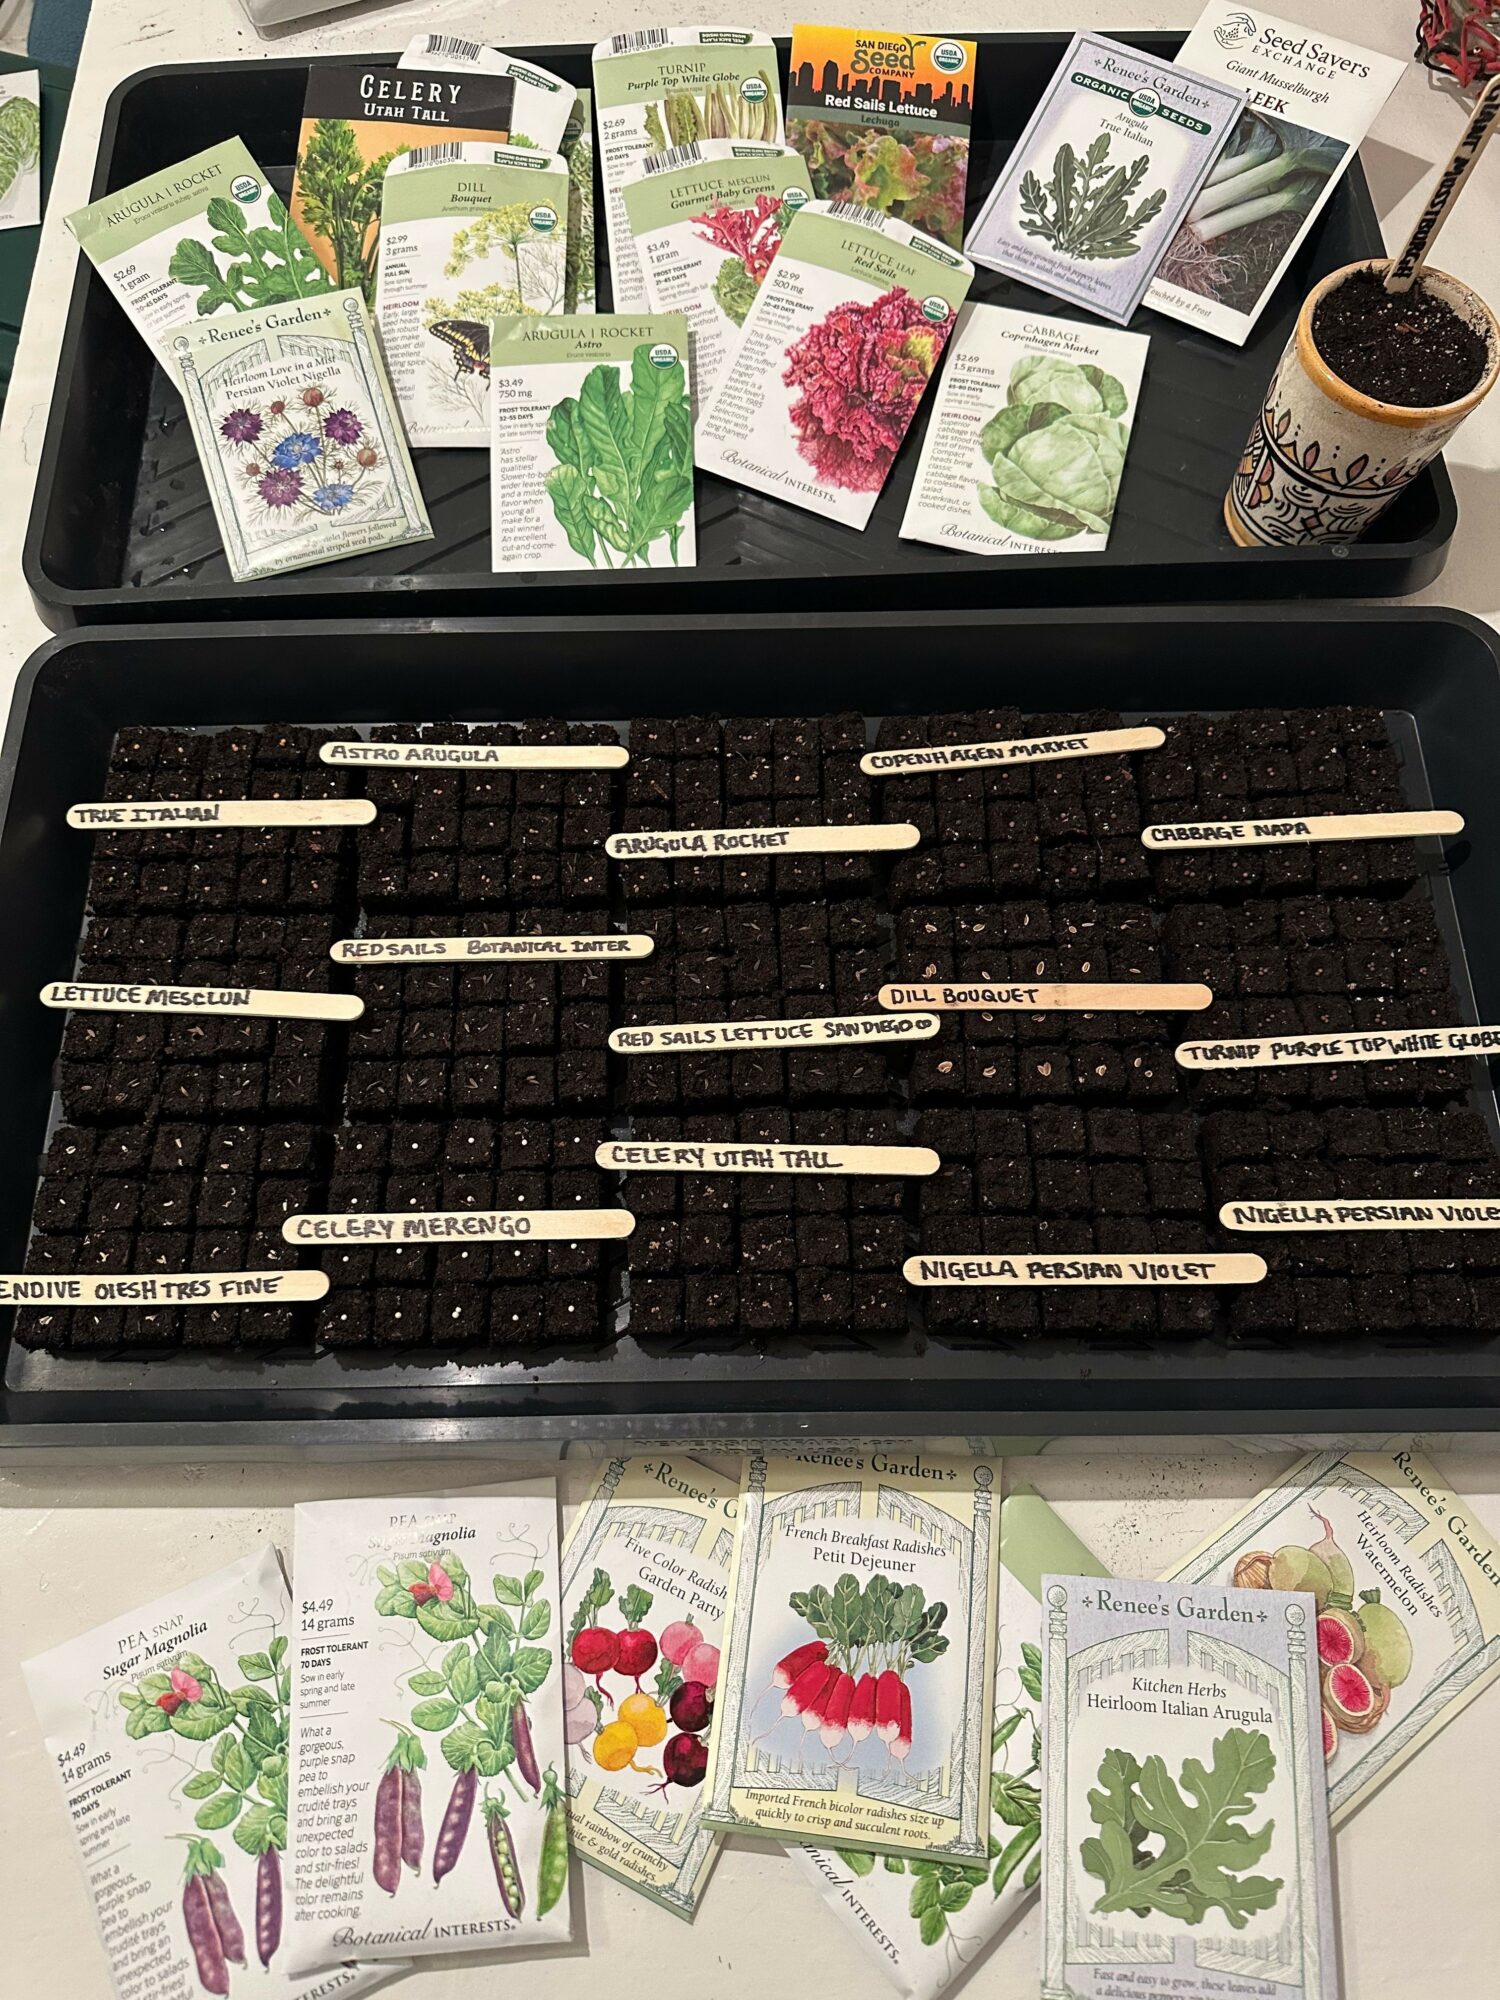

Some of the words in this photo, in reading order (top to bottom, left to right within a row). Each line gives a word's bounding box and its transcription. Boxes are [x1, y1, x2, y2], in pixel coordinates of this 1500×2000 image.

[850, 38, 916, 74] Seed
[856, 40, 875, 49] SAN
[878, 42, 907, 53] DIEGO
[1259, 29, 1307, 54] Seed
[1306, 42, 1370, 78] Savers
[658, 63, 706, 75] TURNIP
[869, 67, 915, 78] COMPANY
[1252, 45, 1337, 80] EXCHANGE
[360, 74, 462, 104] CELERY
[627, 80, 658, 91] Purple
[661, 77, 679, 87] Top
[681, 74, 710, 83] White
[712, 72, 740, 81] Globe
[1074, 74, 1129, 100] ORGANIC
[1102, 57, 1150, 84] Renee's
[1152, 74, 1201, 106] Garden
[1226, 60, 1258, 79] Giant
[1260, 71, 1330, 104] Musselburgh
[825, 94, 851, 108] Red
[854, 98, 886, 111] Sails
[889, 101, 937, 118] Lettuce
[1462, 84, 1500, 153] GIANT
[861, 115, 899, 127] Lechuga
[1116, 112, 1149, 131] Arugula
[1162, 108, 1203, 131] SEEDS
[1100, 118, 1122, 137] True
[1123, 128, 1154, 148] Italian
[106, 192, 168, 228] ARUGULA
[173, 164, 223, 193] ROCKET
[450, 193, 492, 204] Bouquet
[457, 182, 486, 193] DILL
[669, 180, 724, 198] LETTUCE
[728, 175, 771, 186] MESCLUN
[671, 195, 714, 210] Gourmet
[717, 189, 740, 202] Baby
[742, 184, 775, 194] Greens
[841, 239, 895, 267] LETTUCE
[896, 262, 918, 277] LEAF
[854, 256, 868, 268] Red
[869, 262, 897, 280] Sails
[208, 320, 262, 343] Renee's
[265, 308, 322, 330] Garden
[523, 329, 585, 341] ARUGULA
[600, 327, 653, 340] ROCKET
[1023, 324, 1080, 343] CABBAGE
[574, 340, 602, 349] Astro
[1001, 330, 1060, 349] Copenhagen
[1063, 342, 1099, 356] Market
[223, 371, 268, 388] Heirloom
[270, 364, 292, 377] Love
[295, 364, 304, 372] in
[306, 361, 312, 370] a
[315, 356, 336, 369] Mist
[226, 384, 267, 400] Persian
[268, 375, 300, 391] Violet
[303, 368, 341, 385] Nigella
[720, 448, 786, 480] Botanical
[940, 522, 1012, 547] Botanical
[331, 745, 400, 760] ASTRO
[405, 750, 499, 762] ARUGULA
[870, 748, 1004, 770] COPENHAGEN
[1009, 738, 1089, 757] MARKET
[75, 809, 127, 823] TRUE
[130, 804, 220, 822] ITALIAN
[1151, 825, 1245, 842] CABBAGE
[1253, 822, 1311, 838] NAPA
[613, 836, 708, 854] ARUGULA
[467, 940, 566, 954] BOTANICAL
[570, 940, 631, 952] INTER
[50, 986, 141, 1003] LETTUCE
[145, 989, 251, 1006] MESCLUN
[890, 989, 936, 1005] DILL
[942, 988, 1040, 1004] BOUQUET
[617, 1031, 653, 1048] RED
[660, 1029, 716, 1045] SAILS
[721, 1023, 813, 1041] LETTUCE
[1270, 1040, 1342, 1059] PURPLE
[1343, 1037, 1387, 1055] TOP
[611, 1145, 705, 1168] CELERY
[713, 1148, 774, 1168] UTAH
[780, 1151, 844, 1169] TALL
[297, 1219, 394, 1239] CELERY
[403, 1216, 530, 1238] MERENGO
[1232, 1206, 1335, 1224] NIGELLA
[1334, 1207, 1433, 1223] PERSIAN
[920, 1260, 1018, 1281] NIGELLA
[1026, 1261, 1123, 1280] PERSIAN
[1129, 1263, 1216, 1280] VIOLET
[0, 1280, 81, 1299] ENDIVE
[163, 1280, 211, 1300] TRES
[218, 1276, 284, 1297] FINE
[794, 1454, 864, 1474] Renee's
[871, 1455, 944, 1481] Garden
[652, 1462, 718, 1508] Renee's
[1391, 1450, 1446, 1517] Renee's
[1447, 1516, 1500, 1586] Garden
[785, 1524, 827, 1543] French
[830, 1530, 889, 1550] Breakfast
[893, 1538, 947, 1557] Radishes
[624, 1536, 651, 1561] Five
[650, 1551, 686, 1575] Color
[685, 1571, 728, 1600] Radish
[813, 1547, 846, 1562] Petit
[850, 1553, 916, 1575] Dejeuner
[1357, 1509, 1400, 1566] Heirloom
[1399, 1564, 1443, 1619] Radishes
[1356, 1532, 1419, 1618] Watermelon
[638, 1565, 687, 1598] Garden
[689, 1588, 725, 1621] Party
[302, 1599, 334, 1614] $4.49
[1097, 1589, 1170, 1617] Renee's
[1176, 1597, 1254, 1625] Garden
[117, 1631, 149, 1655] PEA
[152, 1615, 184, 1637] SNAP
[301, 1618, 314, 1631] 14
[317, 1615, 355, 1630] grams
[103, 1653, 141, 1681] Sugar
[145, 1620, 208, 1661] Magnolia
[301, 1645, 325, 1656] FROST
[327, 1640, 369, 1653] TOLERANT
[1132, 1678, 1184, 1695] Kitchen
[1187, 1681, 1227, 1699] Herbs
[1087, 1693, 1157, 1713] Heirloom
[1162, 1699, 1209, 1718] Italian
[1213, 1705, 1273, 1726] Arugula
[746, 1789, 790, 1805] Imported
[792, 1796, 826, 1810] French
[829, 1802, 864, 1815] bicolor
[866, 1808, 907, 1821] radishes
[910, 1814, 929, 1824] size
[932, 1817, 944, 1826] up
[332, 1917, 435, 1950] Botanical
